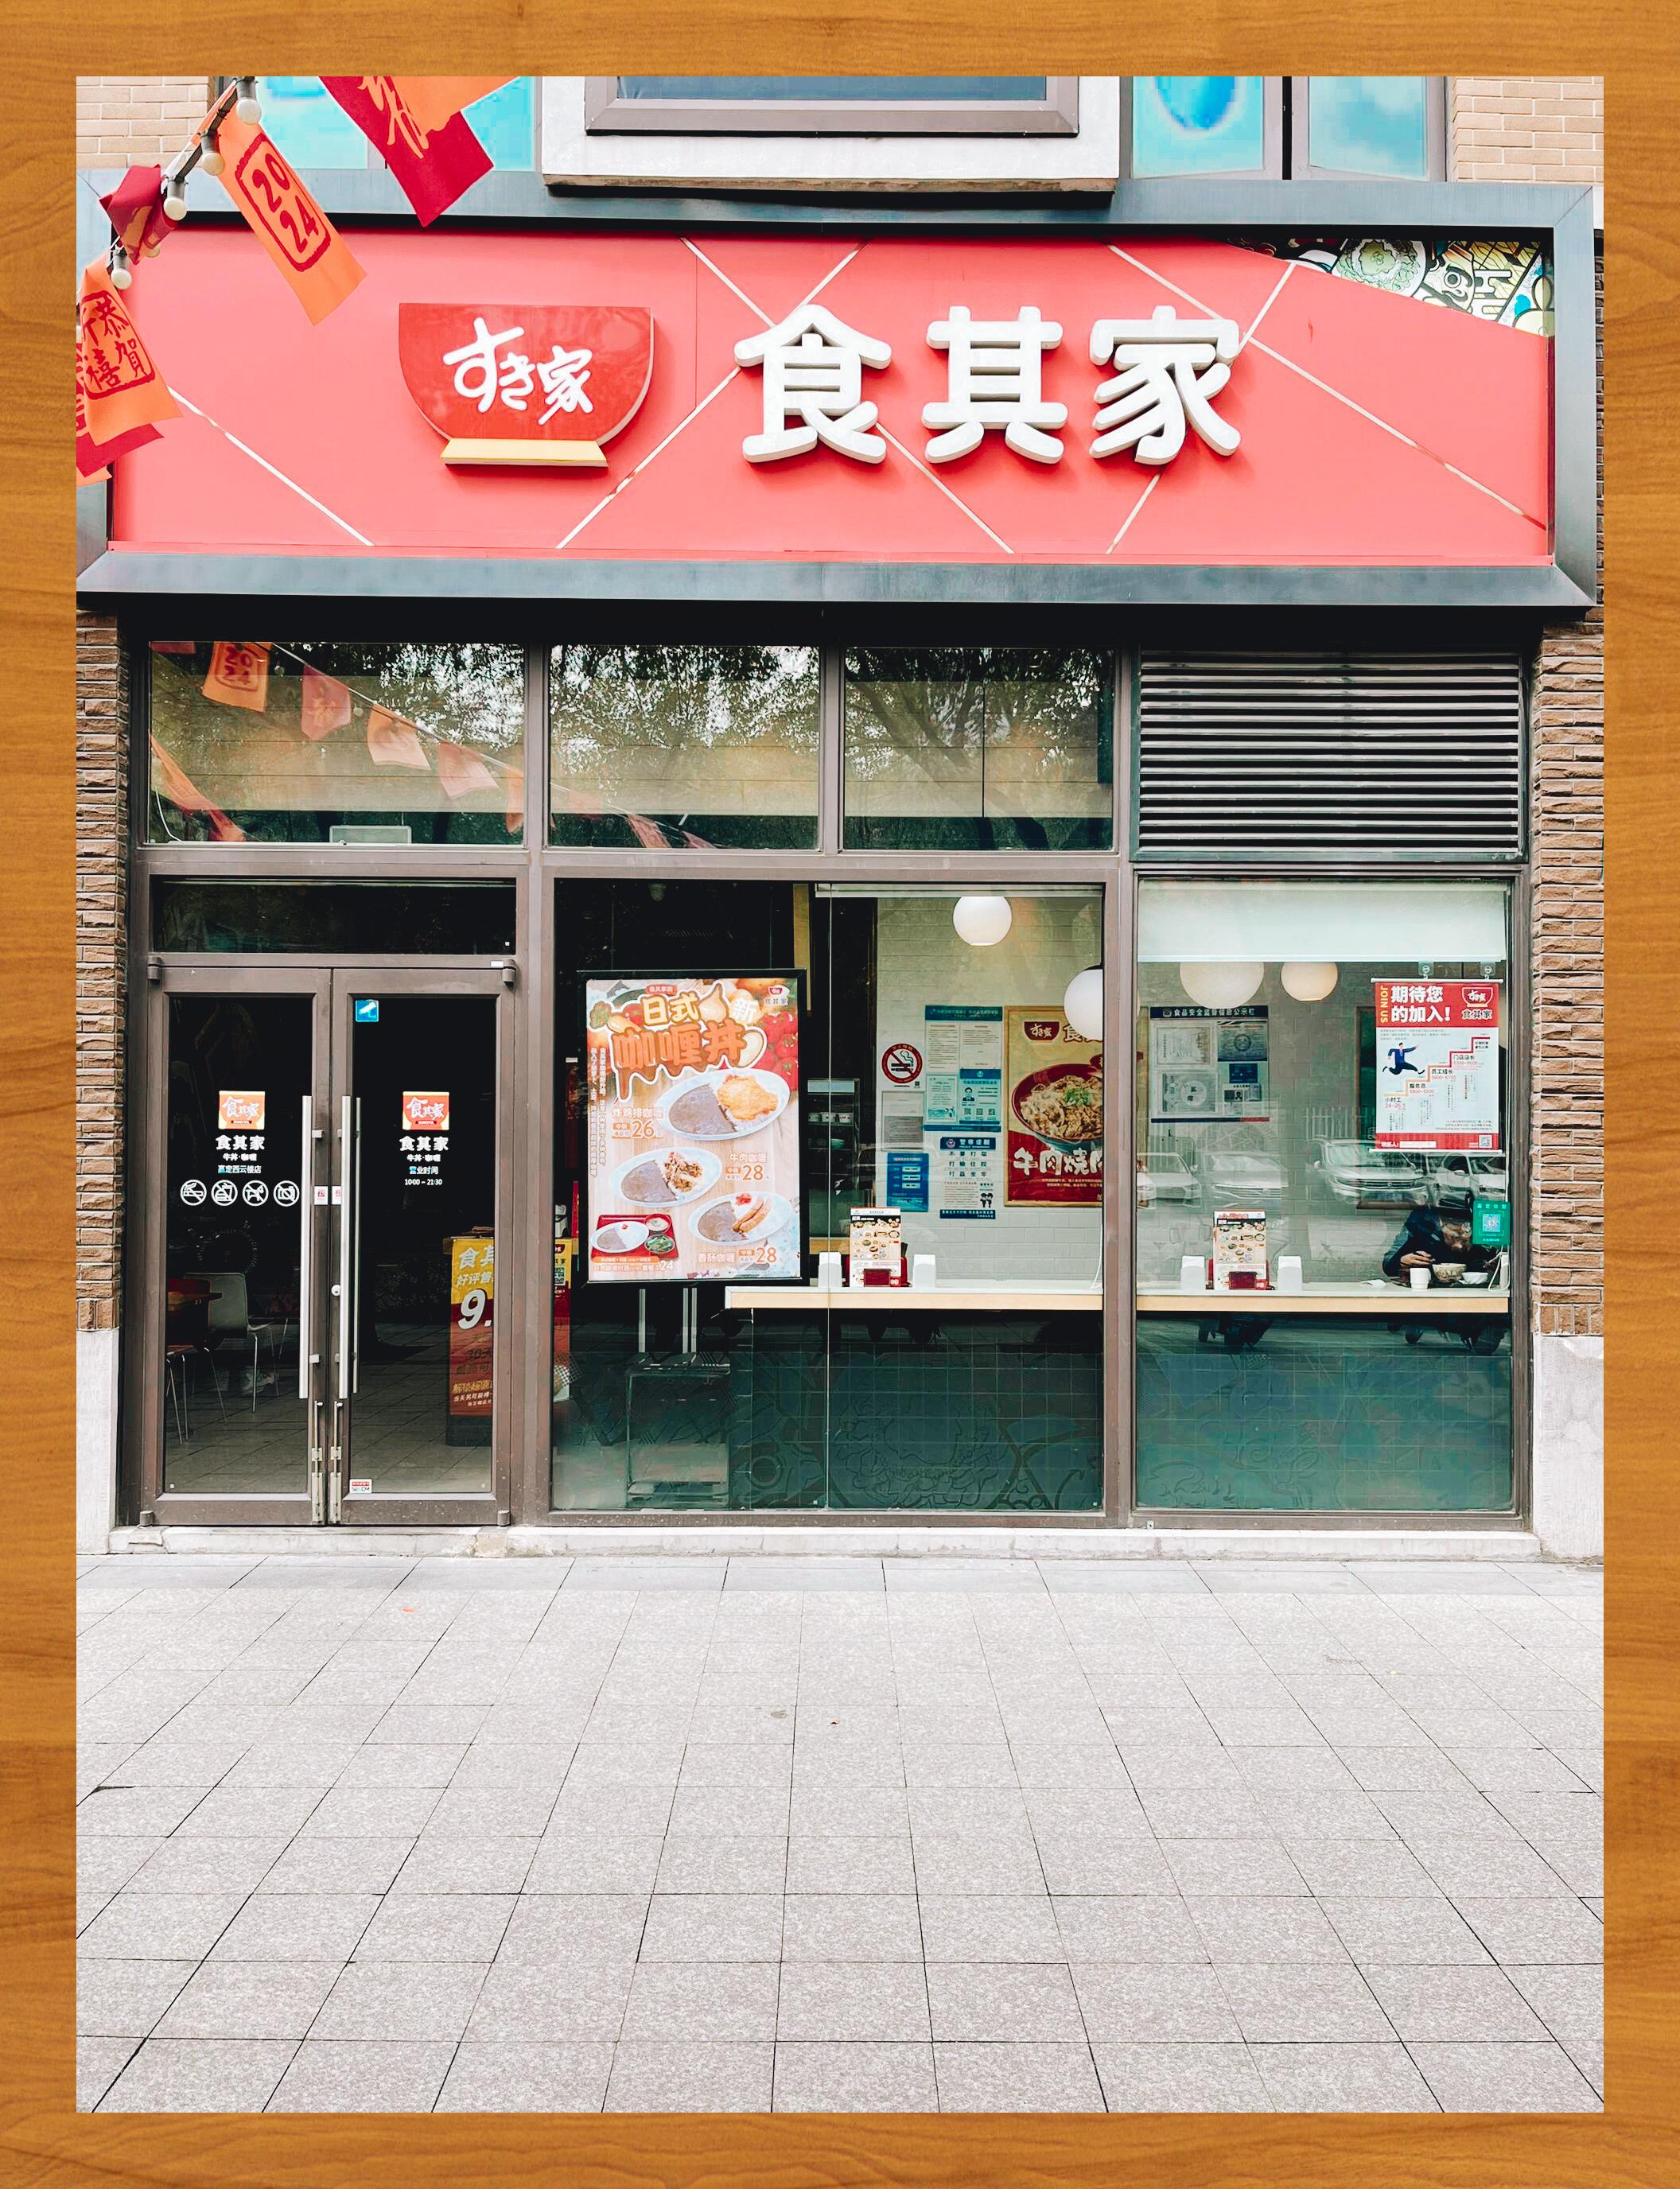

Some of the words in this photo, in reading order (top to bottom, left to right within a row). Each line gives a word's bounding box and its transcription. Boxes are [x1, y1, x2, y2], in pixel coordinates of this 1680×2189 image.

[443, 317, 593, 426] すき家
[734, 304, 1241, 465] 食其家
[1390, 986, 1444, 1003] 期待您
[642, 993, 699, 1025] 日式
[731, 998, 757, 1024] 新
[1380, 1011, 1388, 1023] US
[1390, 1005, 1450, 1023] 的加入!
[1462, 1009, 1492, 1020] 食其家
[612, 1021, 746, 1070] 咖喱丼
[631, 1119, 655, 1138] 26
[215, 1134, 265, 1150] 食其家
[399, 1135, 449, 1151] 食其家
[741, 1164, 764, 1180] 28
[756, 1246, 777, 1263] 28
